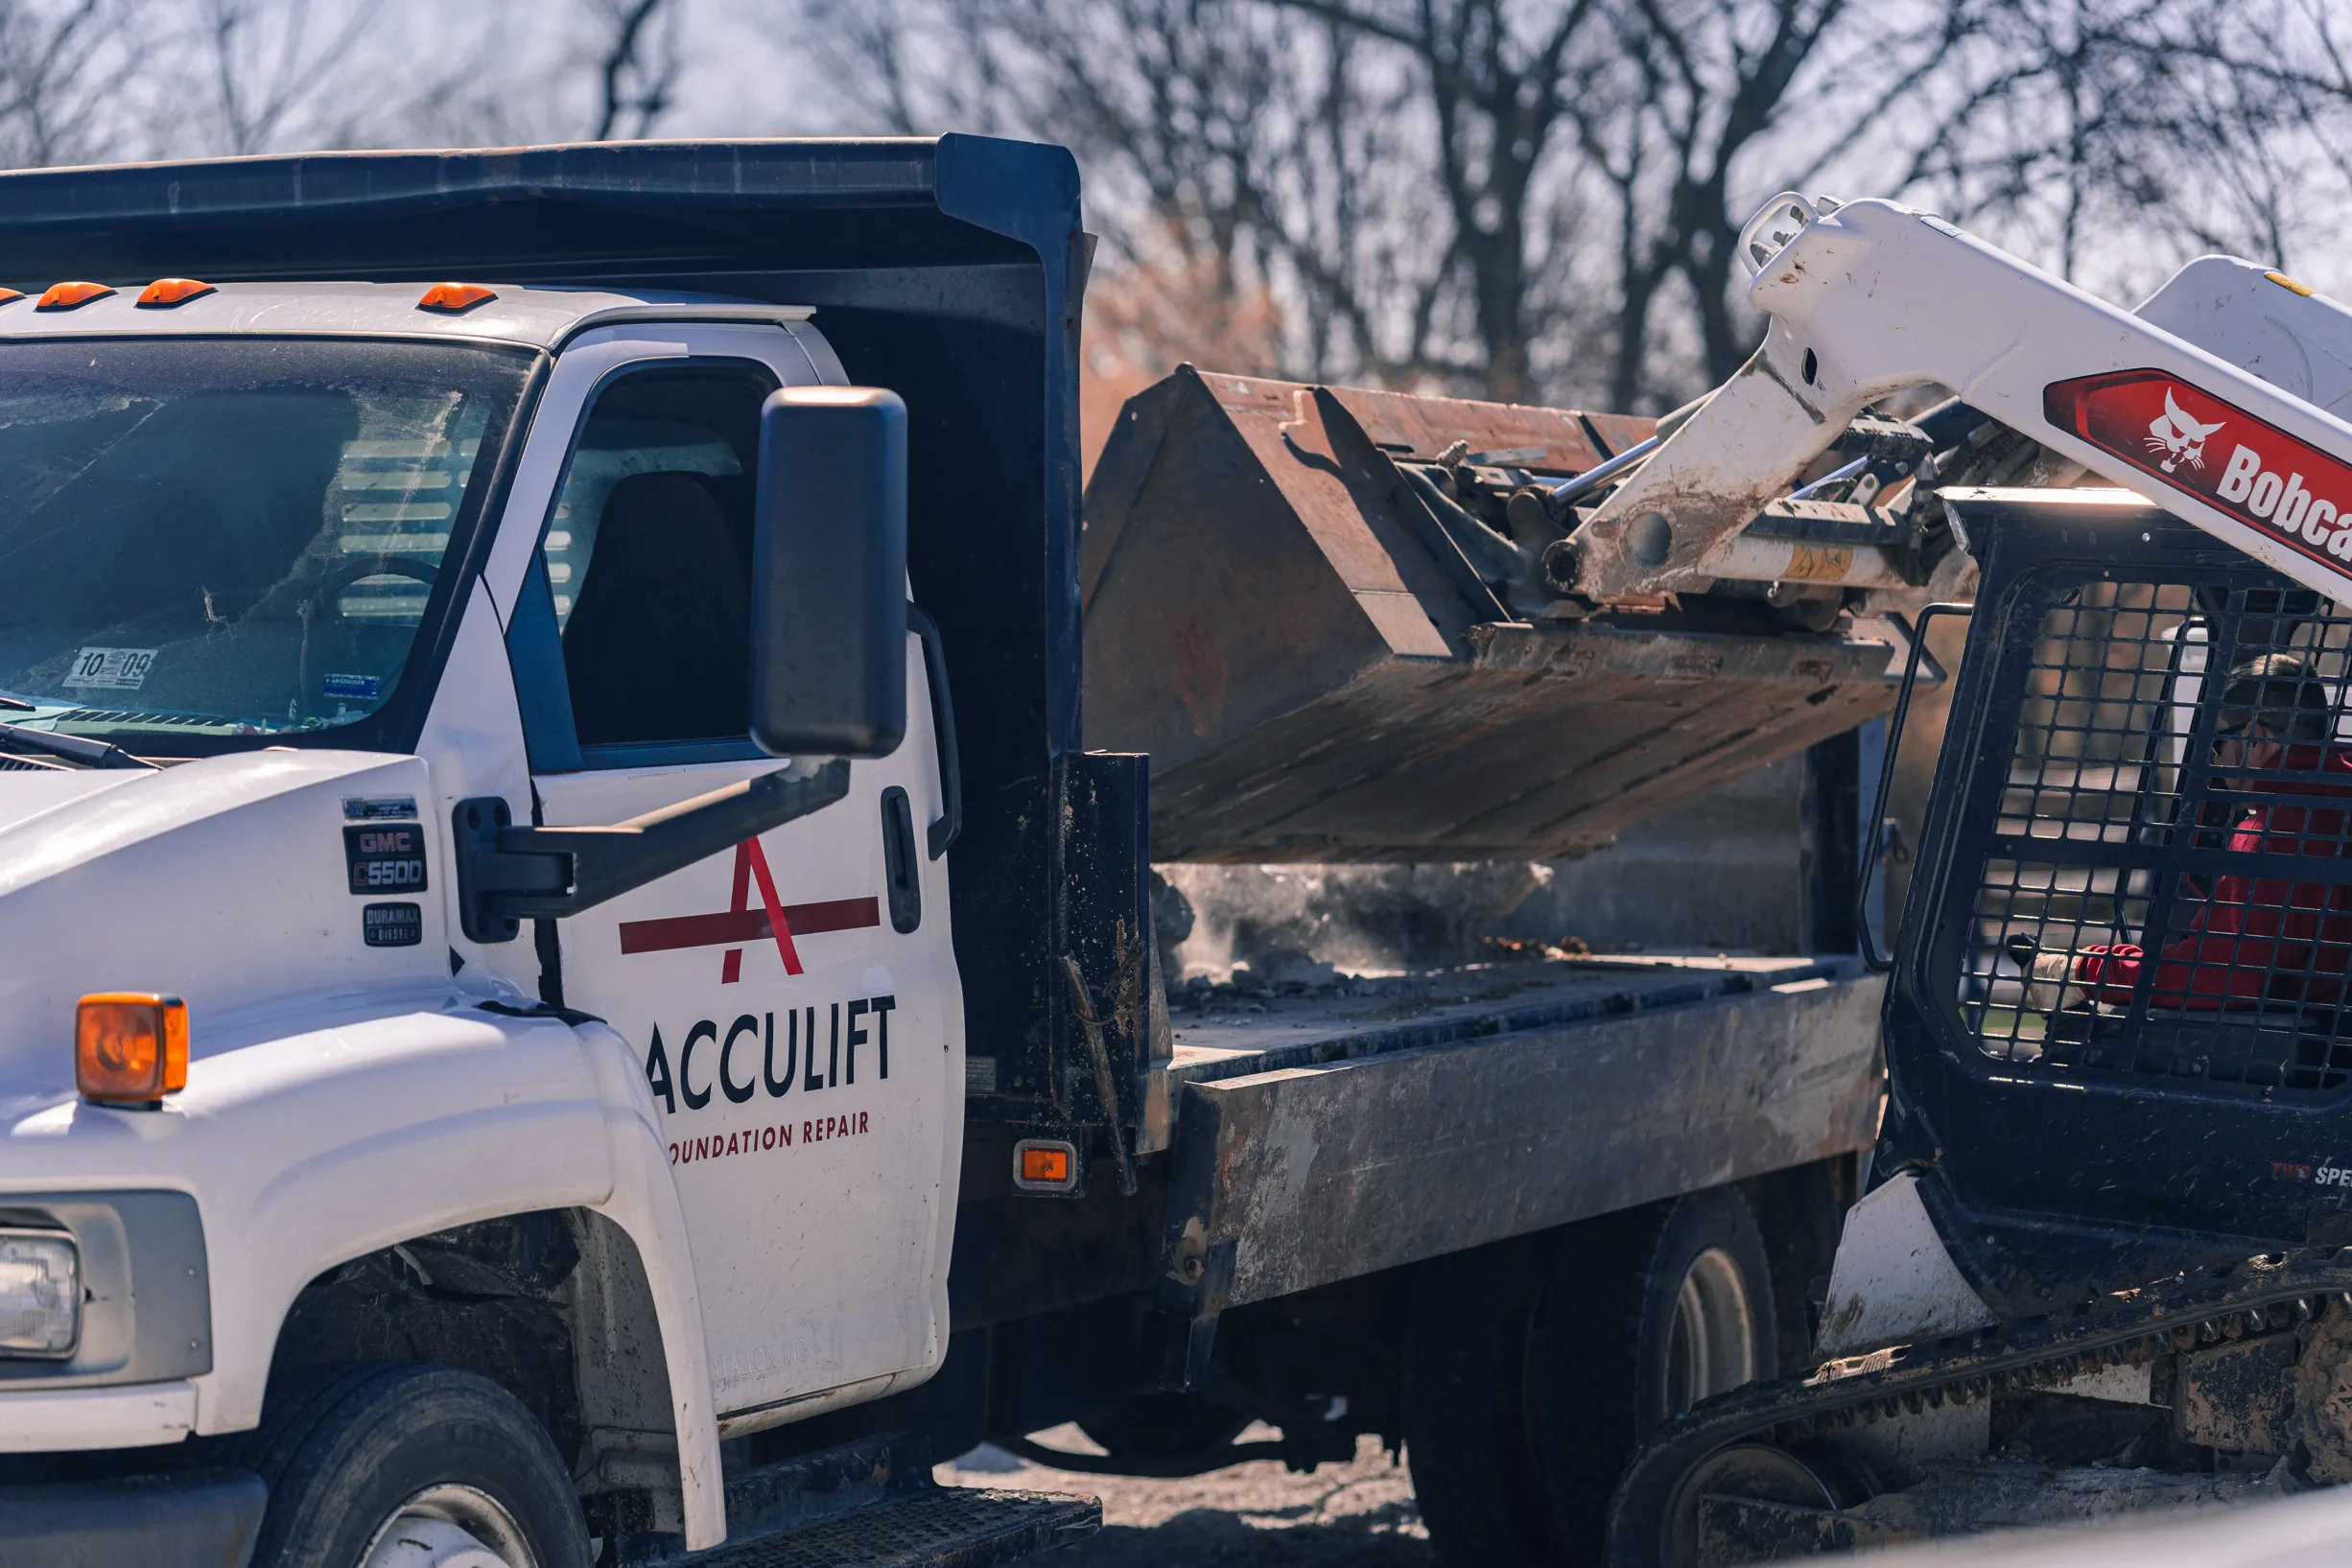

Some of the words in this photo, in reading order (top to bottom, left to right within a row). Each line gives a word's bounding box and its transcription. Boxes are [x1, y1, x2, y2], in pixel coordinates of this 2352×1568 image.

[2216, 443, 2352, 562] Bobca
[80, 652, 105, 676] 10
[120, 653, 151, 677] 09
[360, 832, 411, 853] GMC
[353, 860, 422, 886] C5500
[366, 908, 418, 924] DURAMAX
[378, 928, 409, 941] DIESEL
[646, 995, 896, 1114] ACCULIFT
[669, 1123, 792, 1166] OUNDATION
[803, 1111, 868, 1143] REPAIR
[2315, 1166, 2352, 1187] SPE
